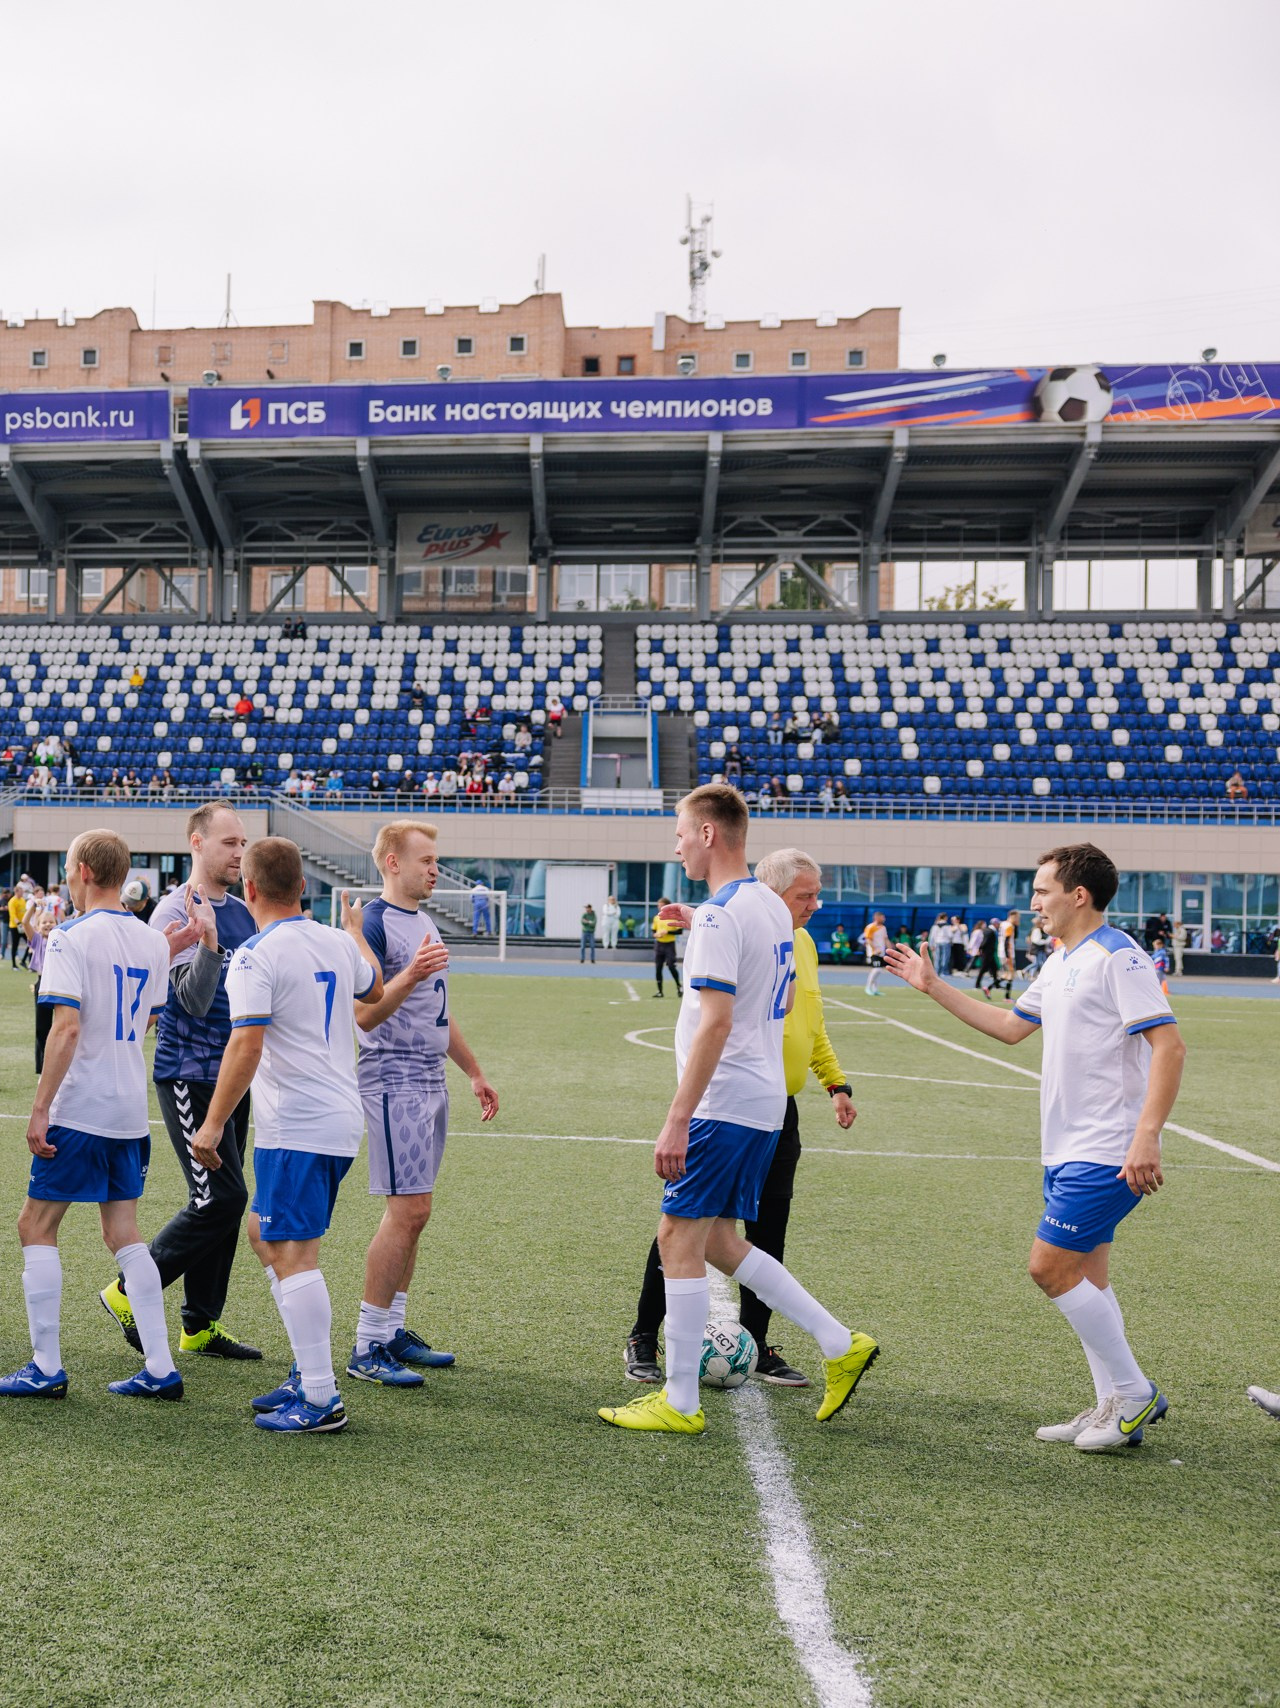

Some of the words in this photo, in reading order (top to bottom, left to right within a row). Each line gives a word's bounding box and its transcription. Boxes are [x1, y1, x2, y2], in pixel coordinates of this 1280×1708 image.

[5, 405, 134, 435] psbank.ru
[267, 401, 326, 425] ПСБ
[368, 399, 437, 424] Банк
[445, 400, 603, 423] настоящих
[610, 398, 773, 420] чемпионов
[113, 964, 149, 1042] 17
[314, 970, 337, 1050] 7
[433, 978, 449, 1027] 2
[1044, 1214, 1079, 1233] KELME
